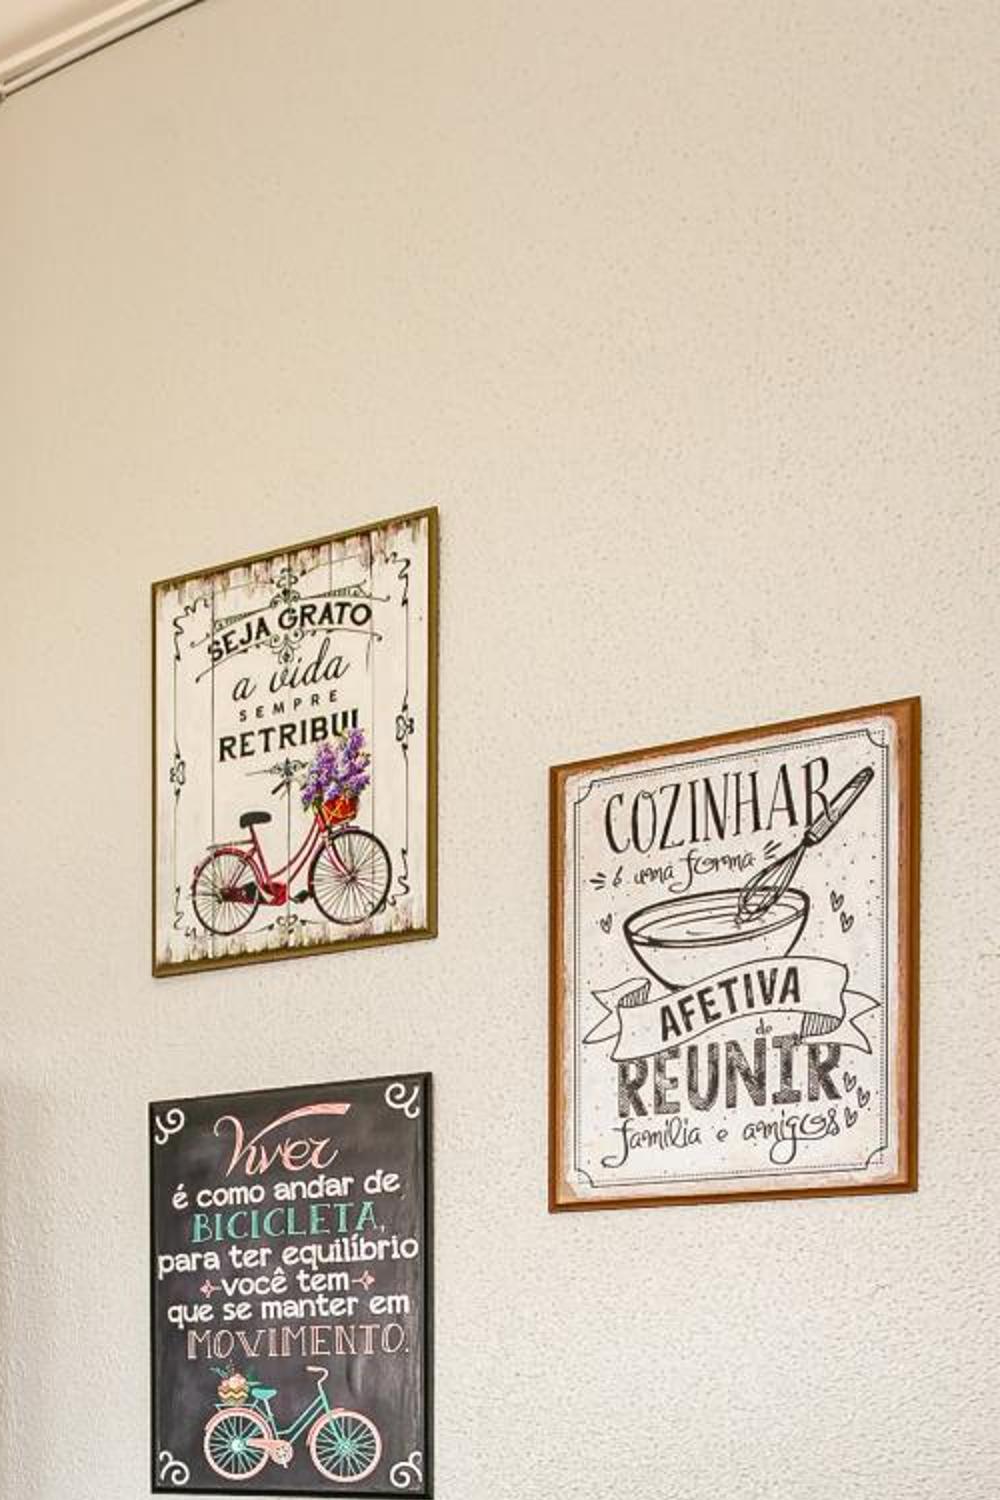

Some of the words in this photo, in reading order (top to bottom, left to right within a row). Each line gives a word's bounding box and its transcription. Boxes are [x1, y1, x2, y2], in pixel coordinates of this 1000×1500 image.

[207, 617, 271, 662] SEJA
[278, 602, 373, 630] GRATO
[232, 674, 256, 701] a
[270, 638, 350, 692] vida
[239, 690, 339, 722] SEMPRE
[219, 710, 358, 762] RETRIBUI
[605, 756, 833, 854] COZINHAR
[634, 867, 674, 885] uma
[668, 850, 755, 892] forma
[661, 966, 801, 1042] AFETIVA
[755, 1018, 772, 1036] de
[617, 1034, 842, 1118] REUNIR
[214, 1103, 351, 1177] Viver
[717, 1128, 729, 1142] e
[742, 1110, 840, 1165] amigos
[172, 1183, 188, 1209] é
[197, 1185, 265, 1208] como
[274, 1175, 354, 1201] andar
[363, 1169, 400, 1193] de
[192, 1201, 385, 1243] BICICLETA,
[157, 1250, 220, 1280] para
[228, 1246, 272, 1268] ter
[283, 1234, 418, 1272] equilíbrio
[221, 1268, 287, 1297] você
[297, 1268, 349, 1291] tem
[167, 1303, 214, 1329] que
[223, 1303, 252, 1321] se
[262, 1296, 359, 1319] manter
[370, 1293, 410, 1315] em
[187, 1323, 409, 1360] MOVIMENTO.
